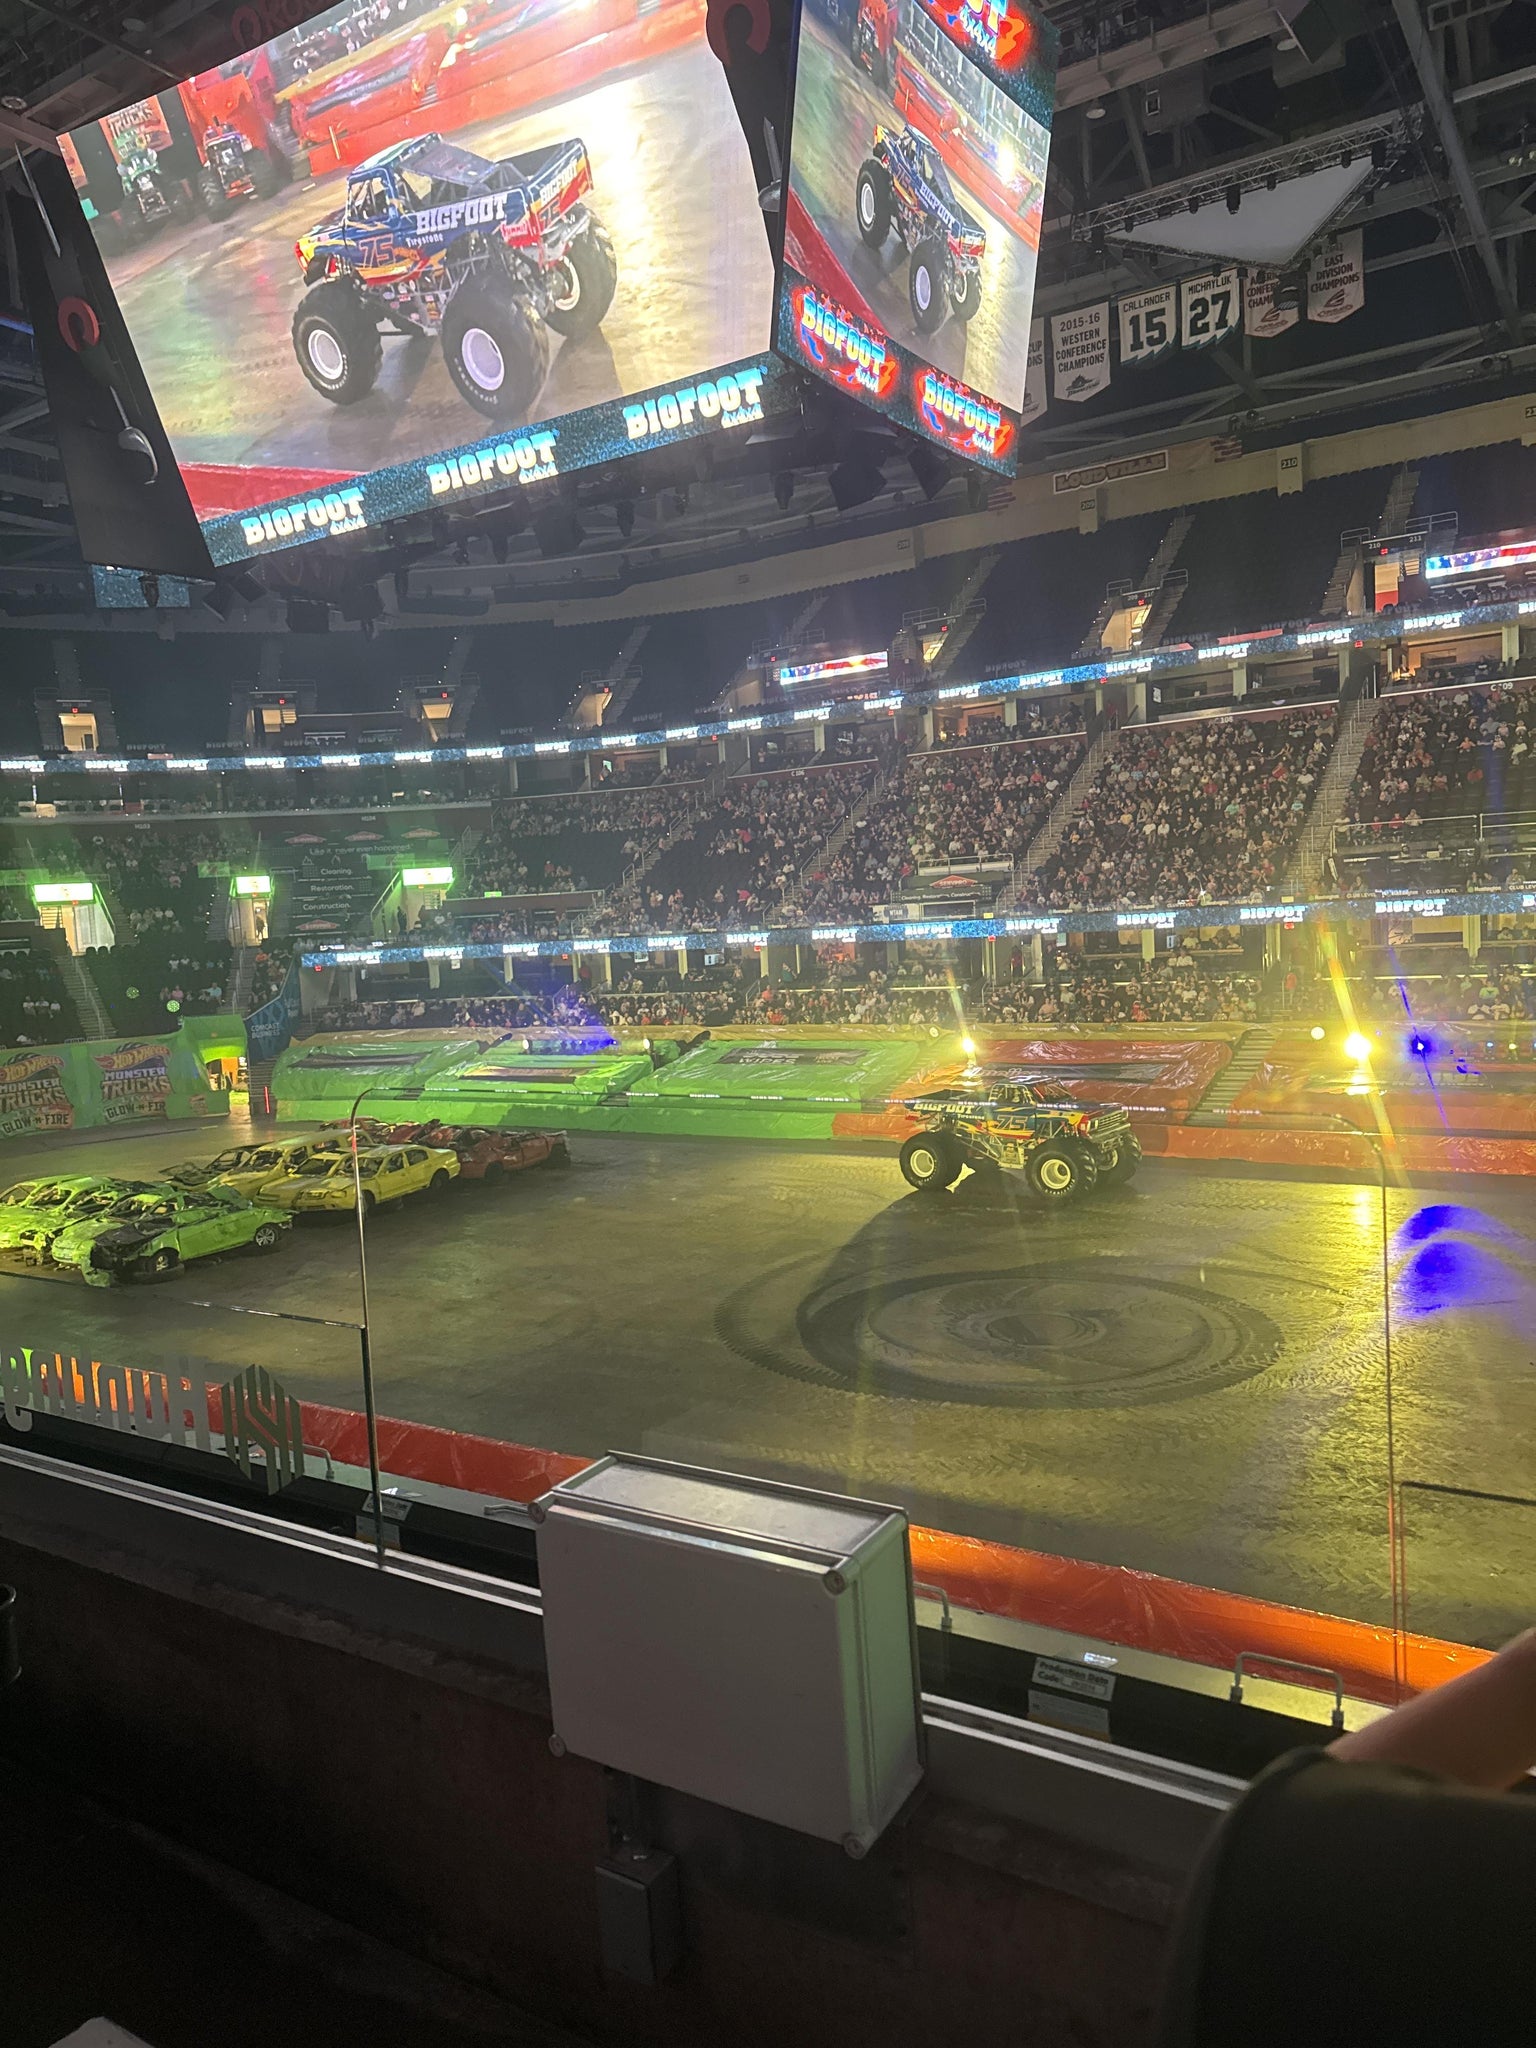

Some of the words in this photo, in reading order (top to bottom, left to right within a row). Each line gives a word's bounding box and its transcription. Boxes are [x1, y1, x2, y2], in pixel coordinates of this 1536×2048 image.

[539, 158, 578, 205] BIGFOOT
[416, 193, 508, 235] BIGFOOT
[919, 180, 957, 230] BIGFOOT
[405, 232, 444, 249] Firestone
[358, 233, 398, 269] 75
[1324, 254, 1345, 268] EAST
[1316, 263, 1354, 281] DIVISION
[1188, 275, 1232, 295] MICHAYLUK
[1310, 272, 1361, 293] CHAMPIONS
[1123, 291, 1171, 313] CALLANDER
[1060, 312, 1100, 332] 2015-16
[1189, 290, 1232, 337] 27
[801, 293, 886, 376] BIGFOOT
[1061, 328, 1100, 347] WESTERN
[1128, 307, 1167, 353] 15
[1055, 339, 1107, 361] CONFERENCE
[1058, 353, 1105, 373] CHAMPIONS
[622, 366, 764, 440] BIGFOOT
[922, 374, 1001, 438] BIGFOOT
[720, 402, 765, 429] 4x4x4
[426, 430, 557, 496] BIGFOOT
[1055, 451, 1168, 493] LOUDVILLE
[1282, 457, 1298, 468] 210
[518, 460, 559, 485] 4x4x4
[240, 486, 366, 546] BIGFOOT
[329, 514, 368, 536] 4x4x4
[1403, 612, 1464, 631] BIGFOOT
[1297, 628, 1353, 645] BIGFOOT
[1198, 643, 1250, 660] BIGFOOT
[1105, 657, 1154, 674] BIGFOOT
[1018, 671, 1064, 686] BIGFOOT
[938, 684, 982, 699] BIGFOOT
[864, 696, 904, 710] BIGFOOT
[794, 707, 834, 720] BIGFOOT
[320, 867, 354, 876] Cleaning.
[310, 884, 355, 892] Restoration.
[302, 902, 352, 911] Construction.
[1239, 905, 1306, 920] BIGFOOT
[1375, 898, 1448, 914] BIGFOOT
[1005, 918, 1060, 931] BIGFOOT
[1116, 911, 1178, 926] BIGFOOT
[726, 933, 771, 944] BIGFOOT
[812, 928, 858, 940] BIGFOOT
[904, 923, 954, 936] BIGFOOT
[251, 1022, 280, 1032] COMCAST
[114, 1053, 134, 1069] HOT
[134, 1045, 169, 1064] WHEELS
[7, 1065, 27, 1081] HOT
[28, 1055, 63, 1074] WHEELS
[104, 1066, 167, 1081] MONSTER
[0, 1077, 61, 1094] MONSTER
[102, 1075, 171, 1100] TRUCKS
[914, 1101, 975, 1115] BIGFOOT
[996, 1115, 1029, 1131] 75
[1039, 1661, 1087, 1680] Production
